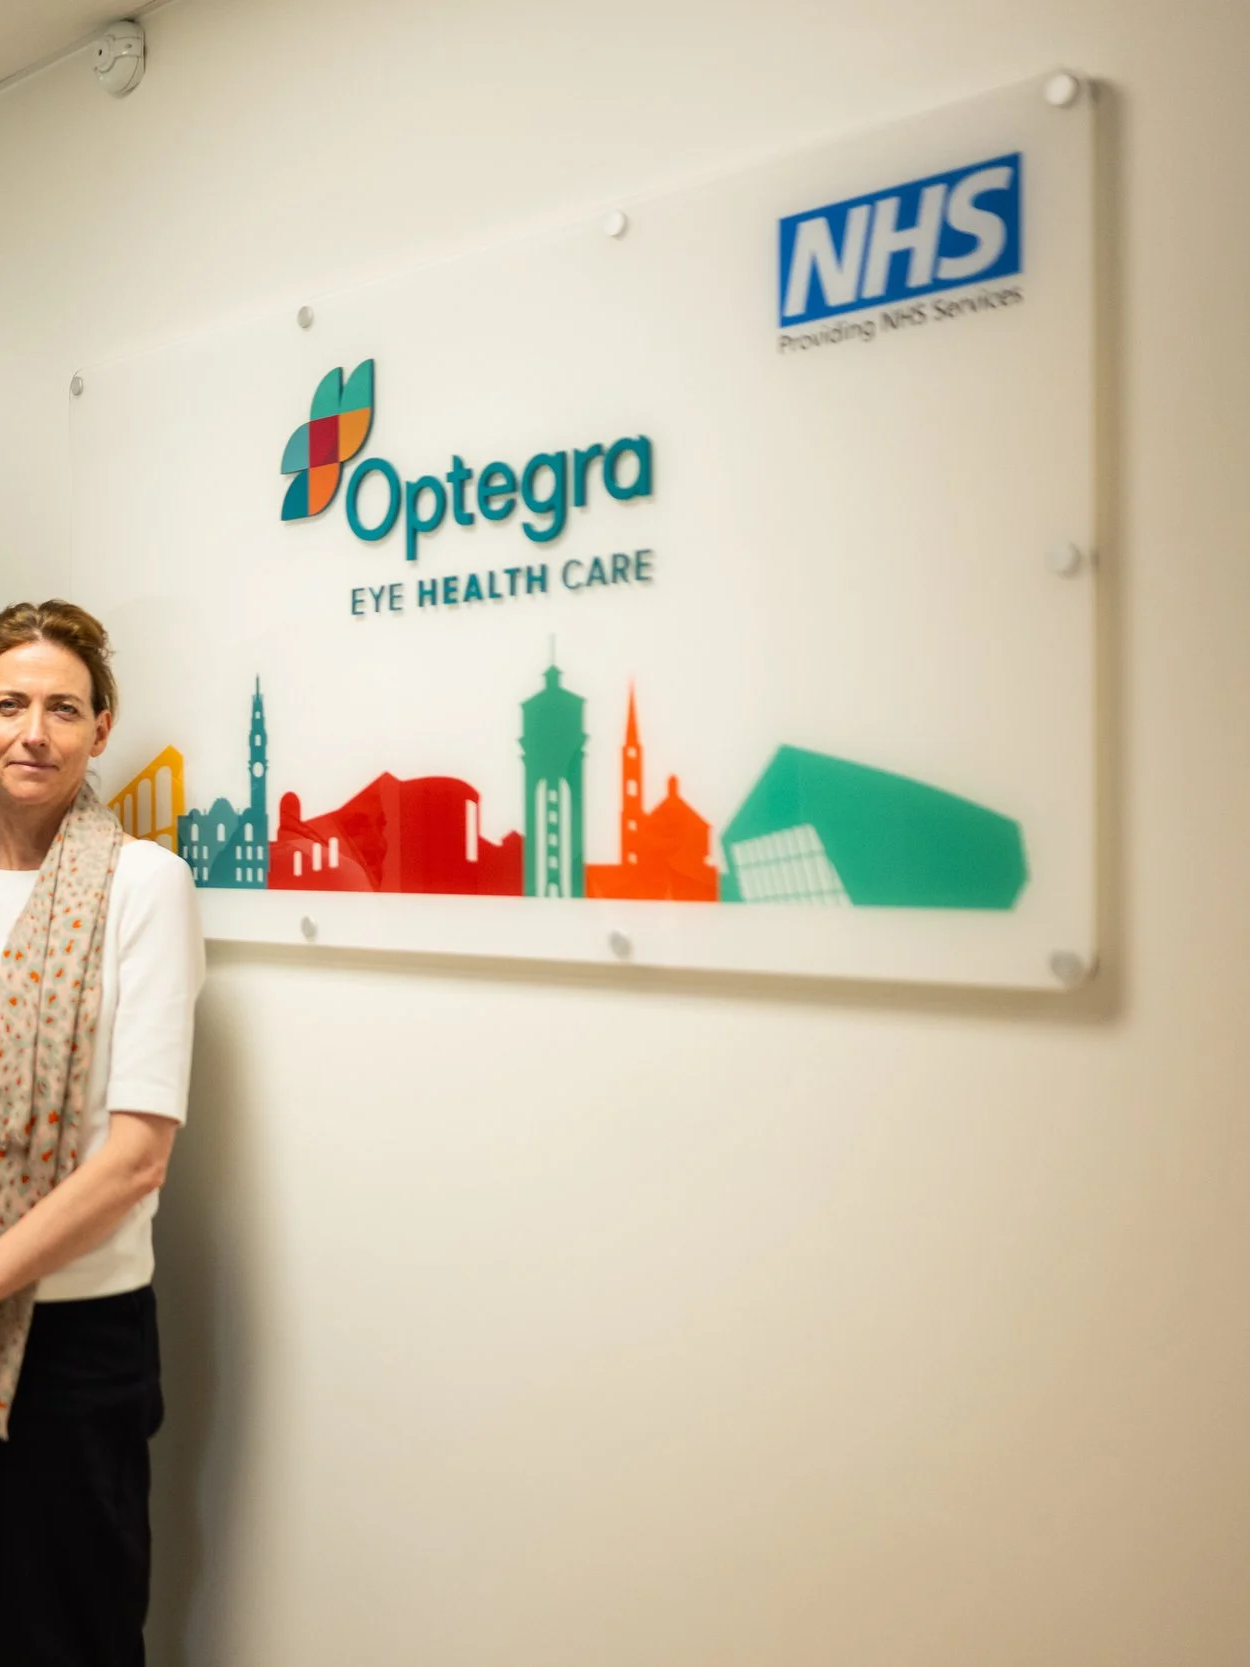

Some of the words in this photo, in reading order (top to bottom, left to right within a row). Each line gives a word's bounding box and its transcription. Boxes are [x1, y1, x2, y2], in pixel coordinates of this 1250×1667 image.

[783, 166, 1014, 317] NHS
[779, 320, 877, 352] Providing
[881, 303, 927, 331] NHS
[933, 286, 1024, 321] Services
[346, 434, 652, 561] Optegra
[351, 583, 403, 615] EYE
[418, 564, 548, 607] HEALTH
[562, 549, 654, 590] CARE
